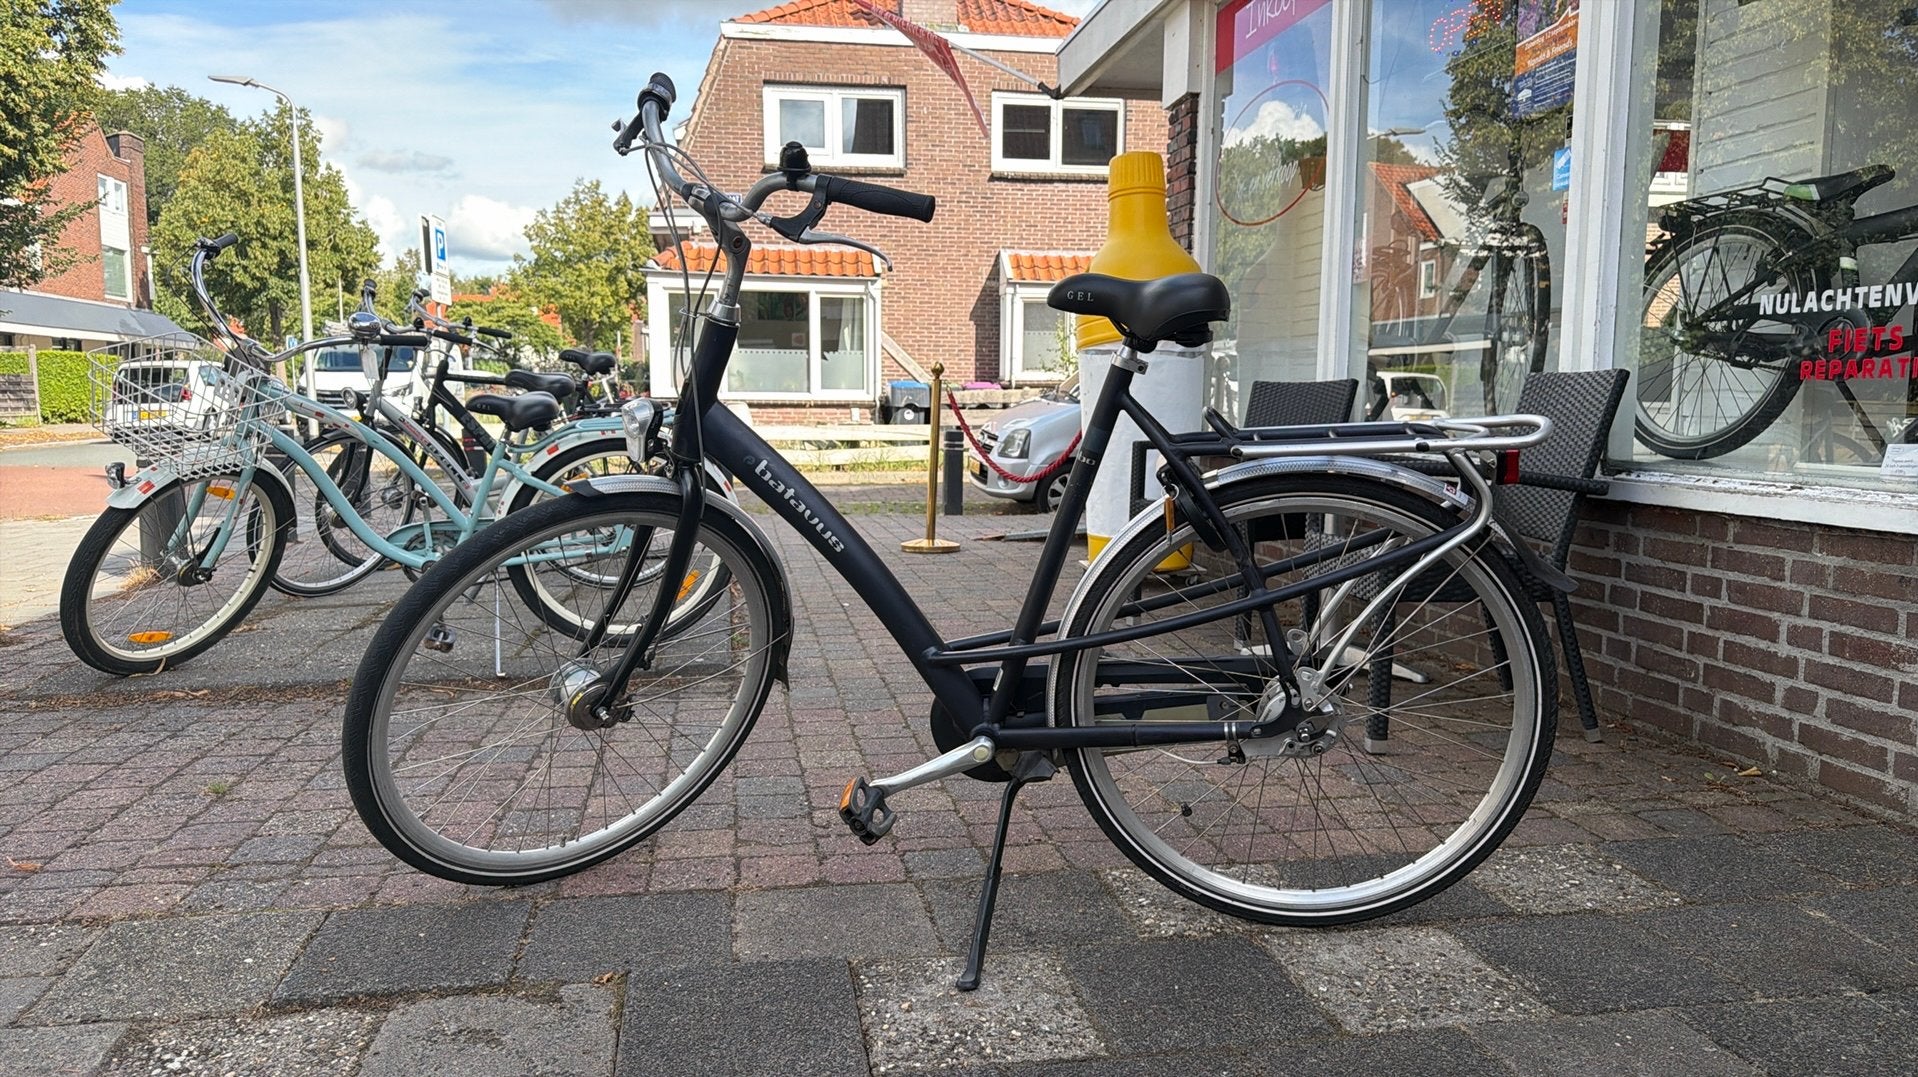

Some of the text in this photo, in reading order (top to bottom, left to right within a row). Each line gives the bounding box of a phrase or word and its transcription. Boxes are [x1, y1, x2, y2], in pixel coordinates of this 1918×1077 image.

[1429, 0, 1502, 52] OPEN
[436, 230, 445, 258] P
[1066, 290, 1094, 302] GEL
[1759, 282, 1918, 316] NULACHTENV
[1828, 325, 1904, 353] FIETS
[754, 459, 845, 553] batavus
